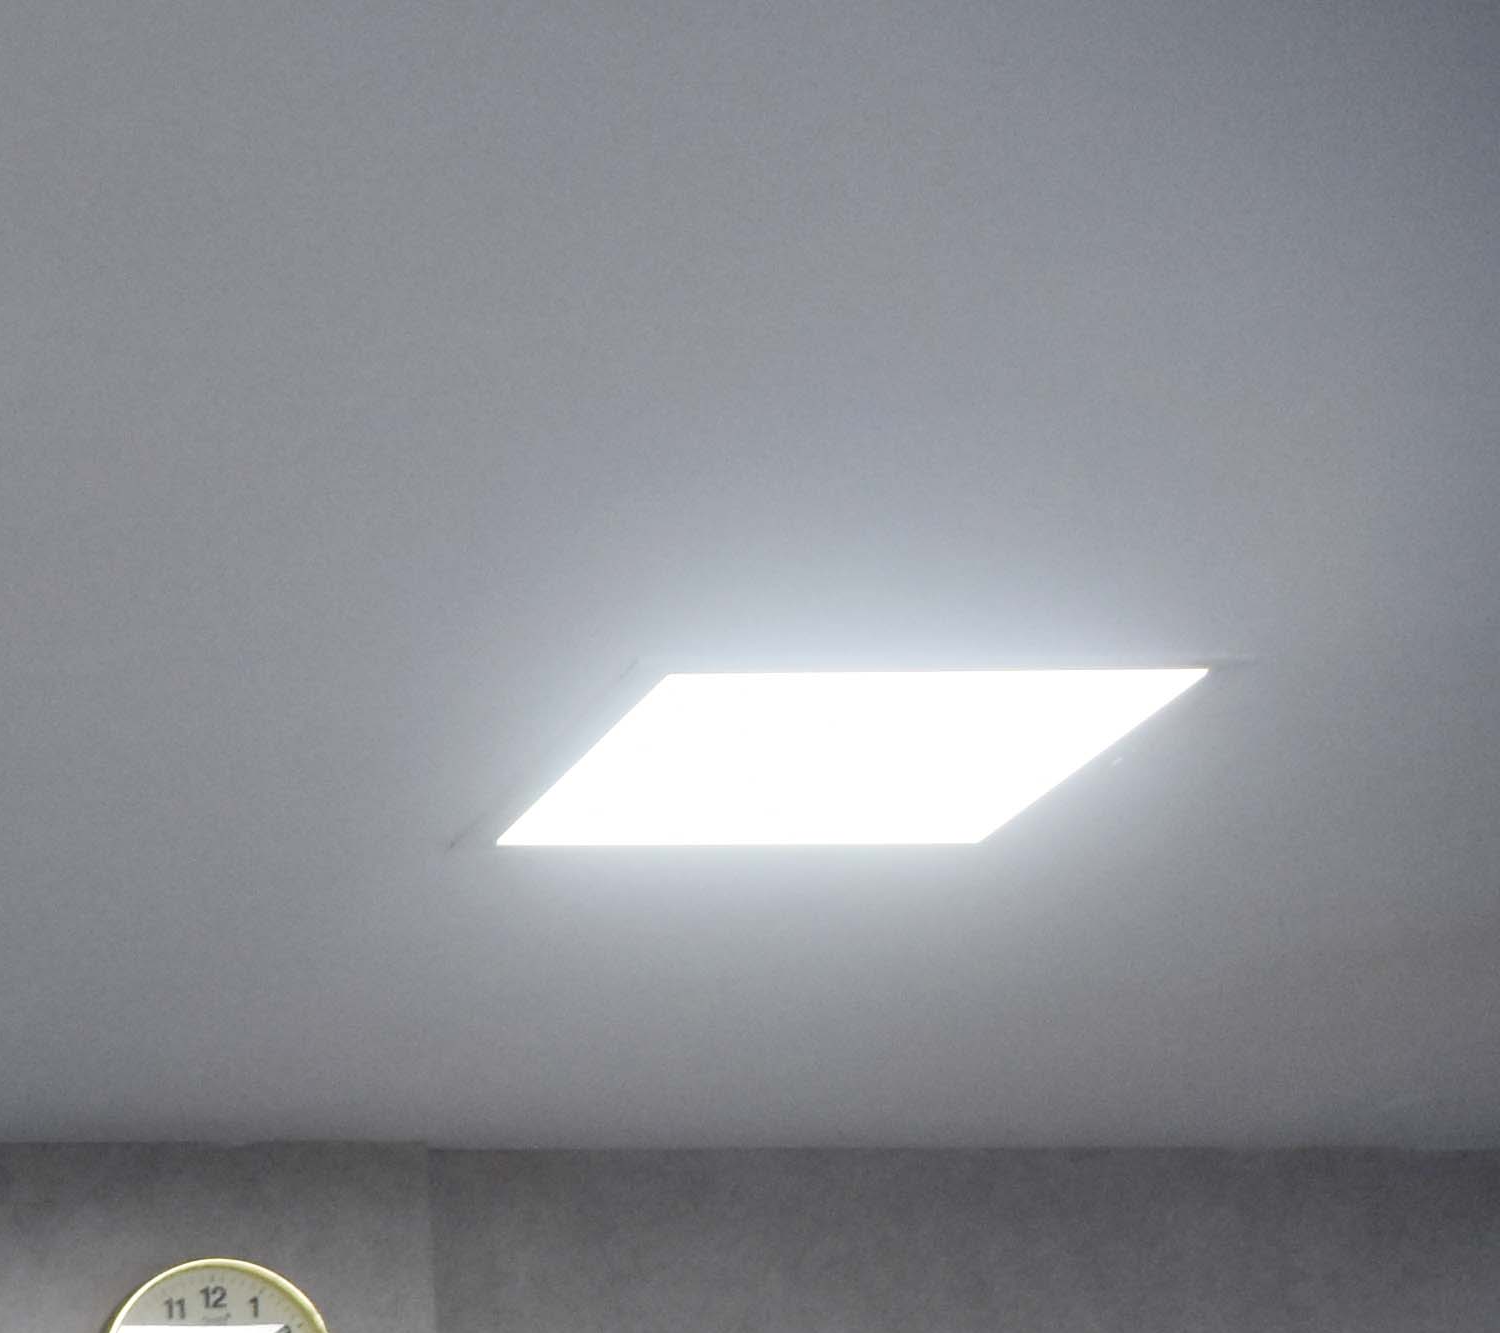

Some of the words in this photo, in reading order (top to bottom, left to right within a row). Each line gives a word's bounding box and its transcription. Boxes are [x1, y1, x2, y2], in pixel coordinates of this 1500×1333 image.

[164, 1297, 186, 1319] 11
[200, 1286, 227, 1309] 12
[248, 1297, 260, 1318] 1
